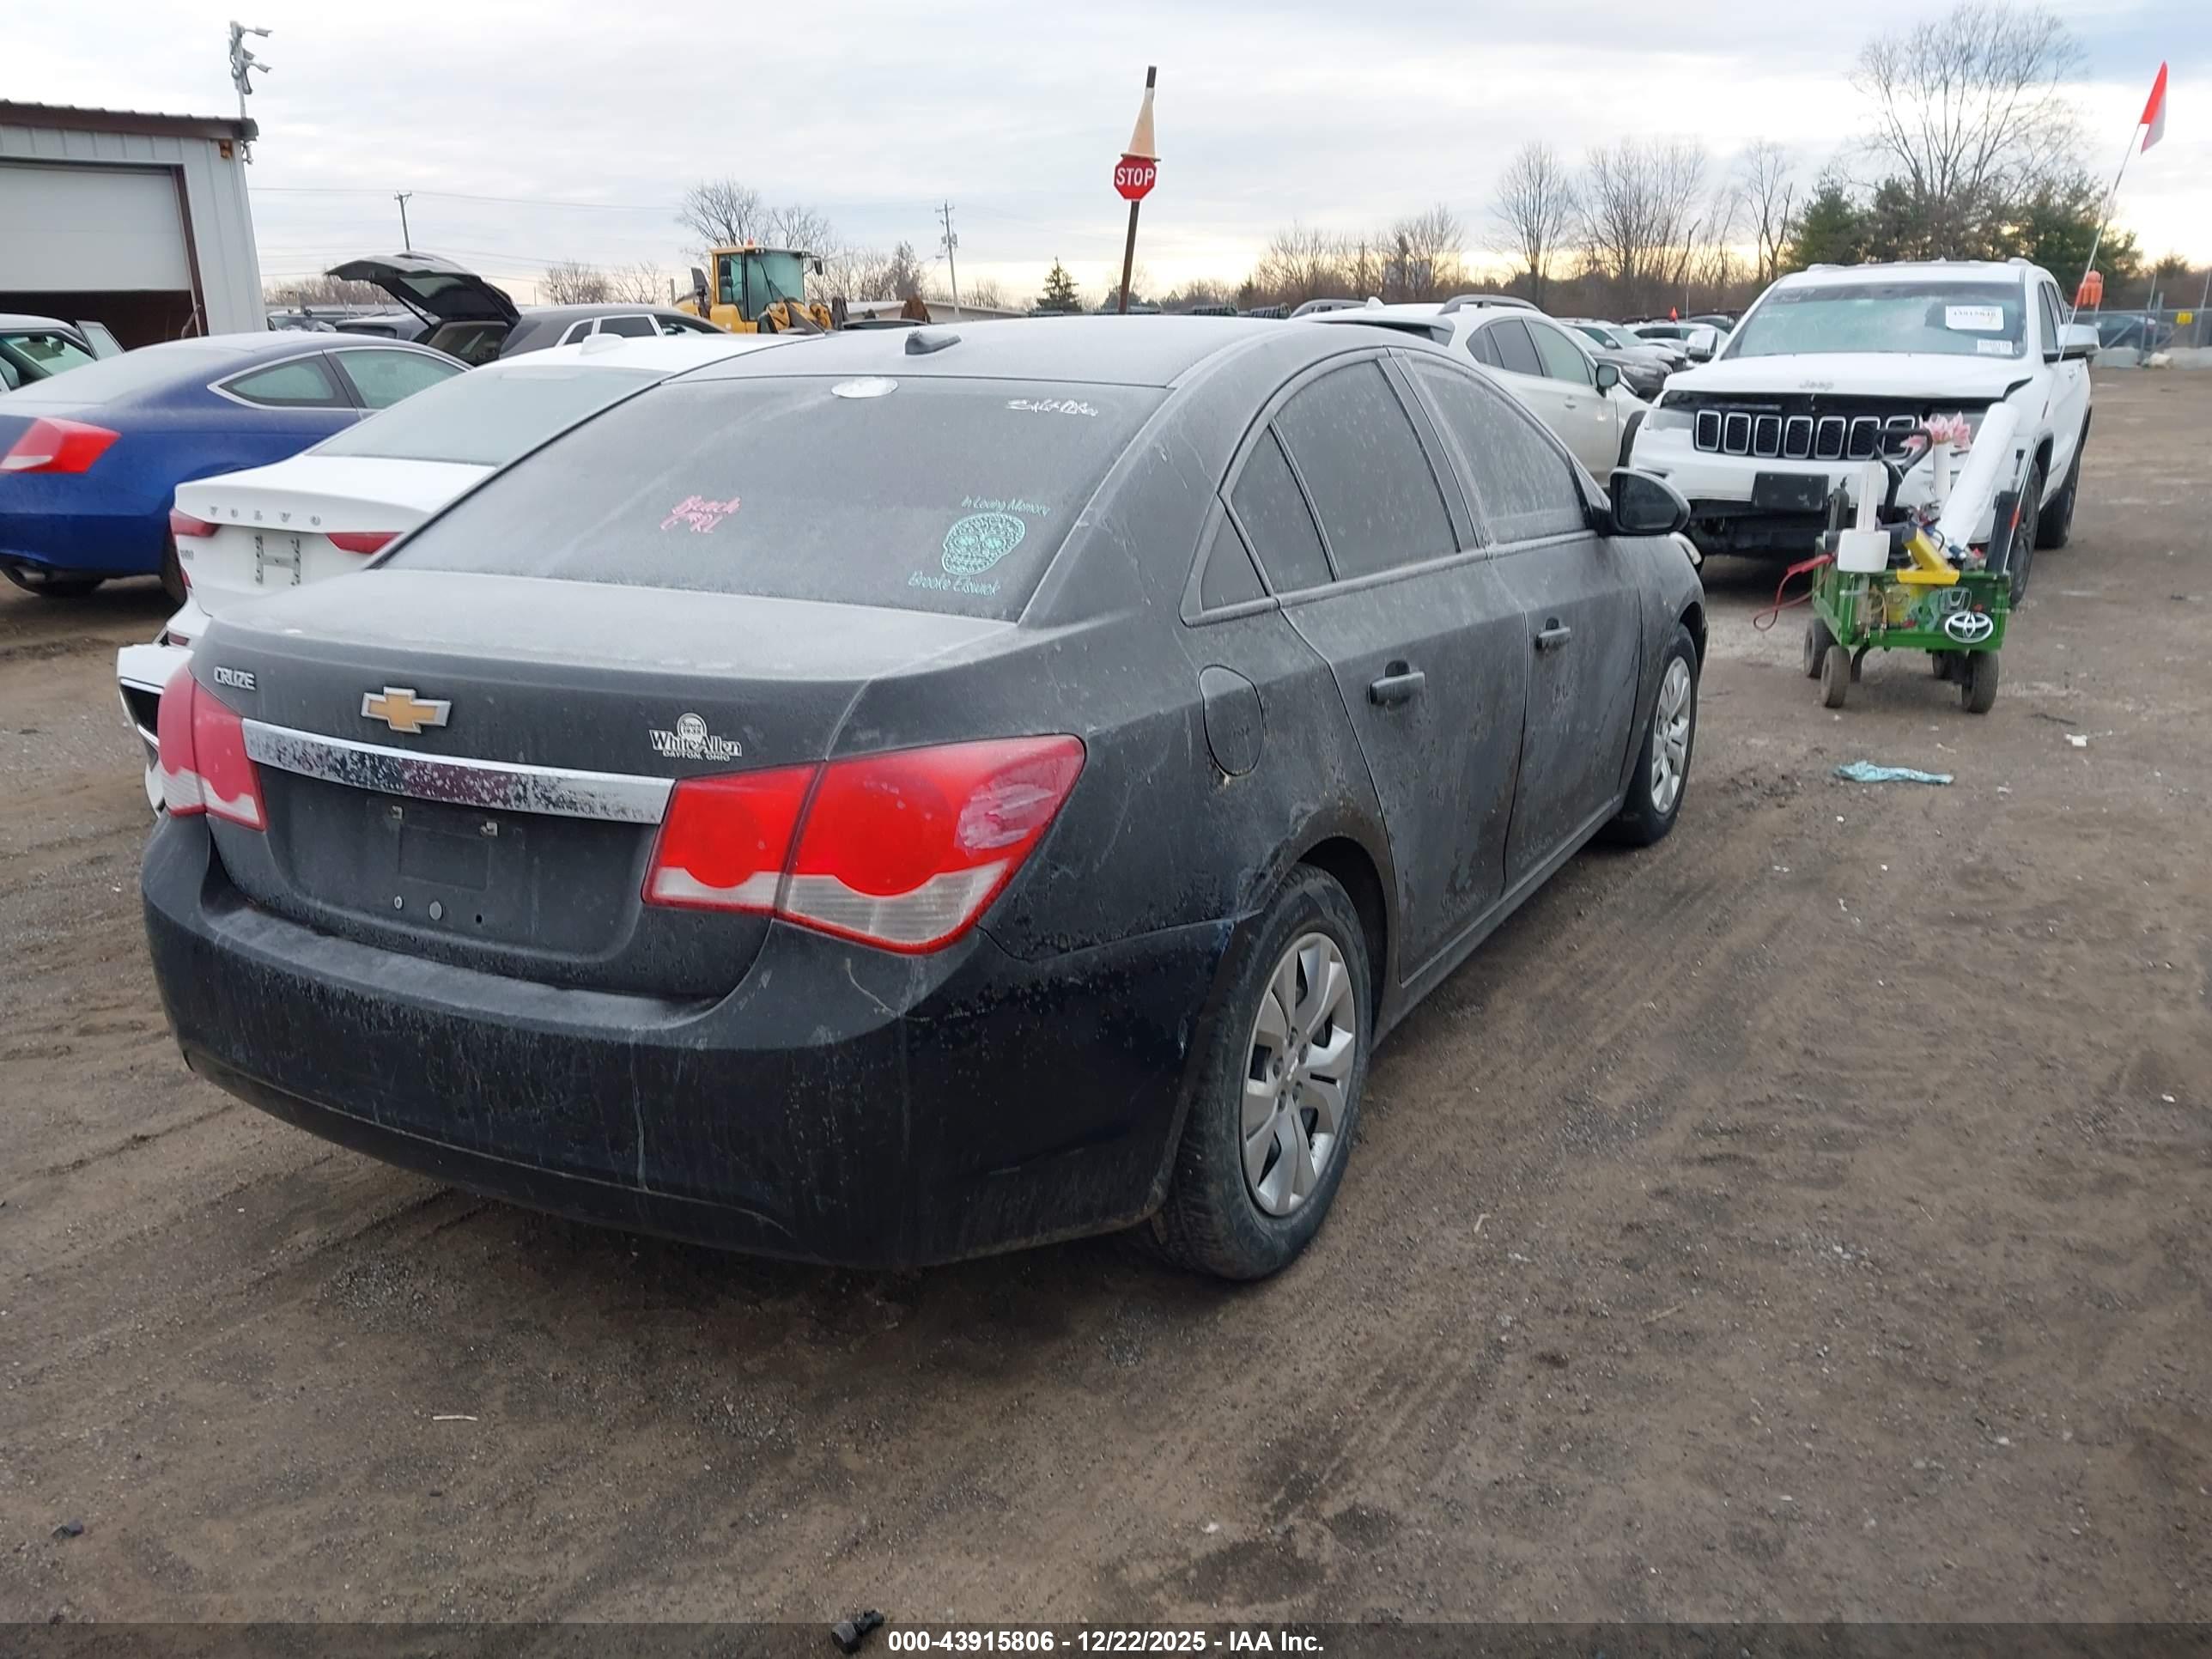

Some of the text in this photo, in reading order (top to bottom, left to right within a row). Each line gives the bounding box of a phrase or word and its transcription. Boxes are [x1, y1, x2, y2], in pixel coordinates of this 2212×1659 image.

[1115, 167, 1155, 187] STOP
[213, 665, 257, 691] CRUZE
[706, 750, 732, 763] OHIO
